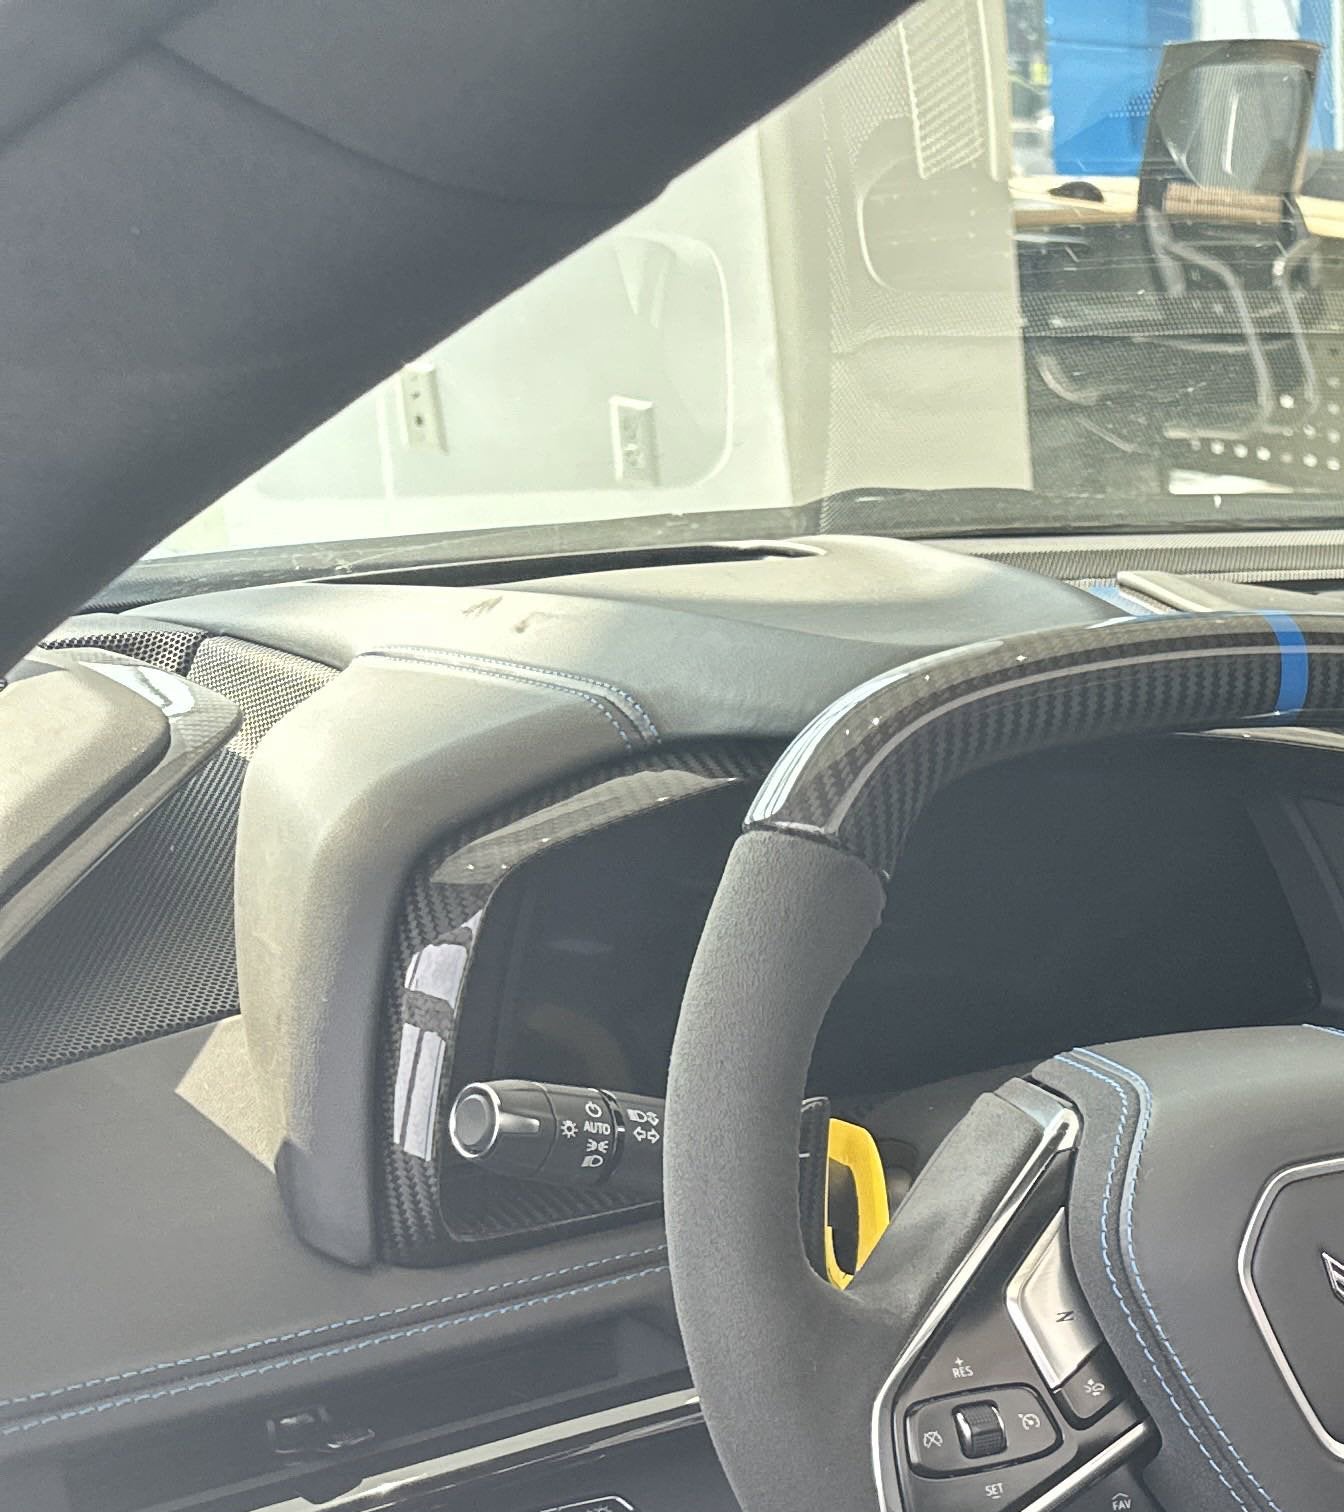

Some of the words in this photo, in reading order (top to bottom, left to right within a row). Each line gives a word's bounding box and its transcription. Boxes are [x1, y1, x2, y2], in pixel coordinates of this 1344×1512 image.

[583, 1120, 611, 1136] AUTO
[951, 1364, 974, 1379] RES
[985, 1483, 1004, 1497] SET
[1112, 1499, 1132, 1512] FAV
